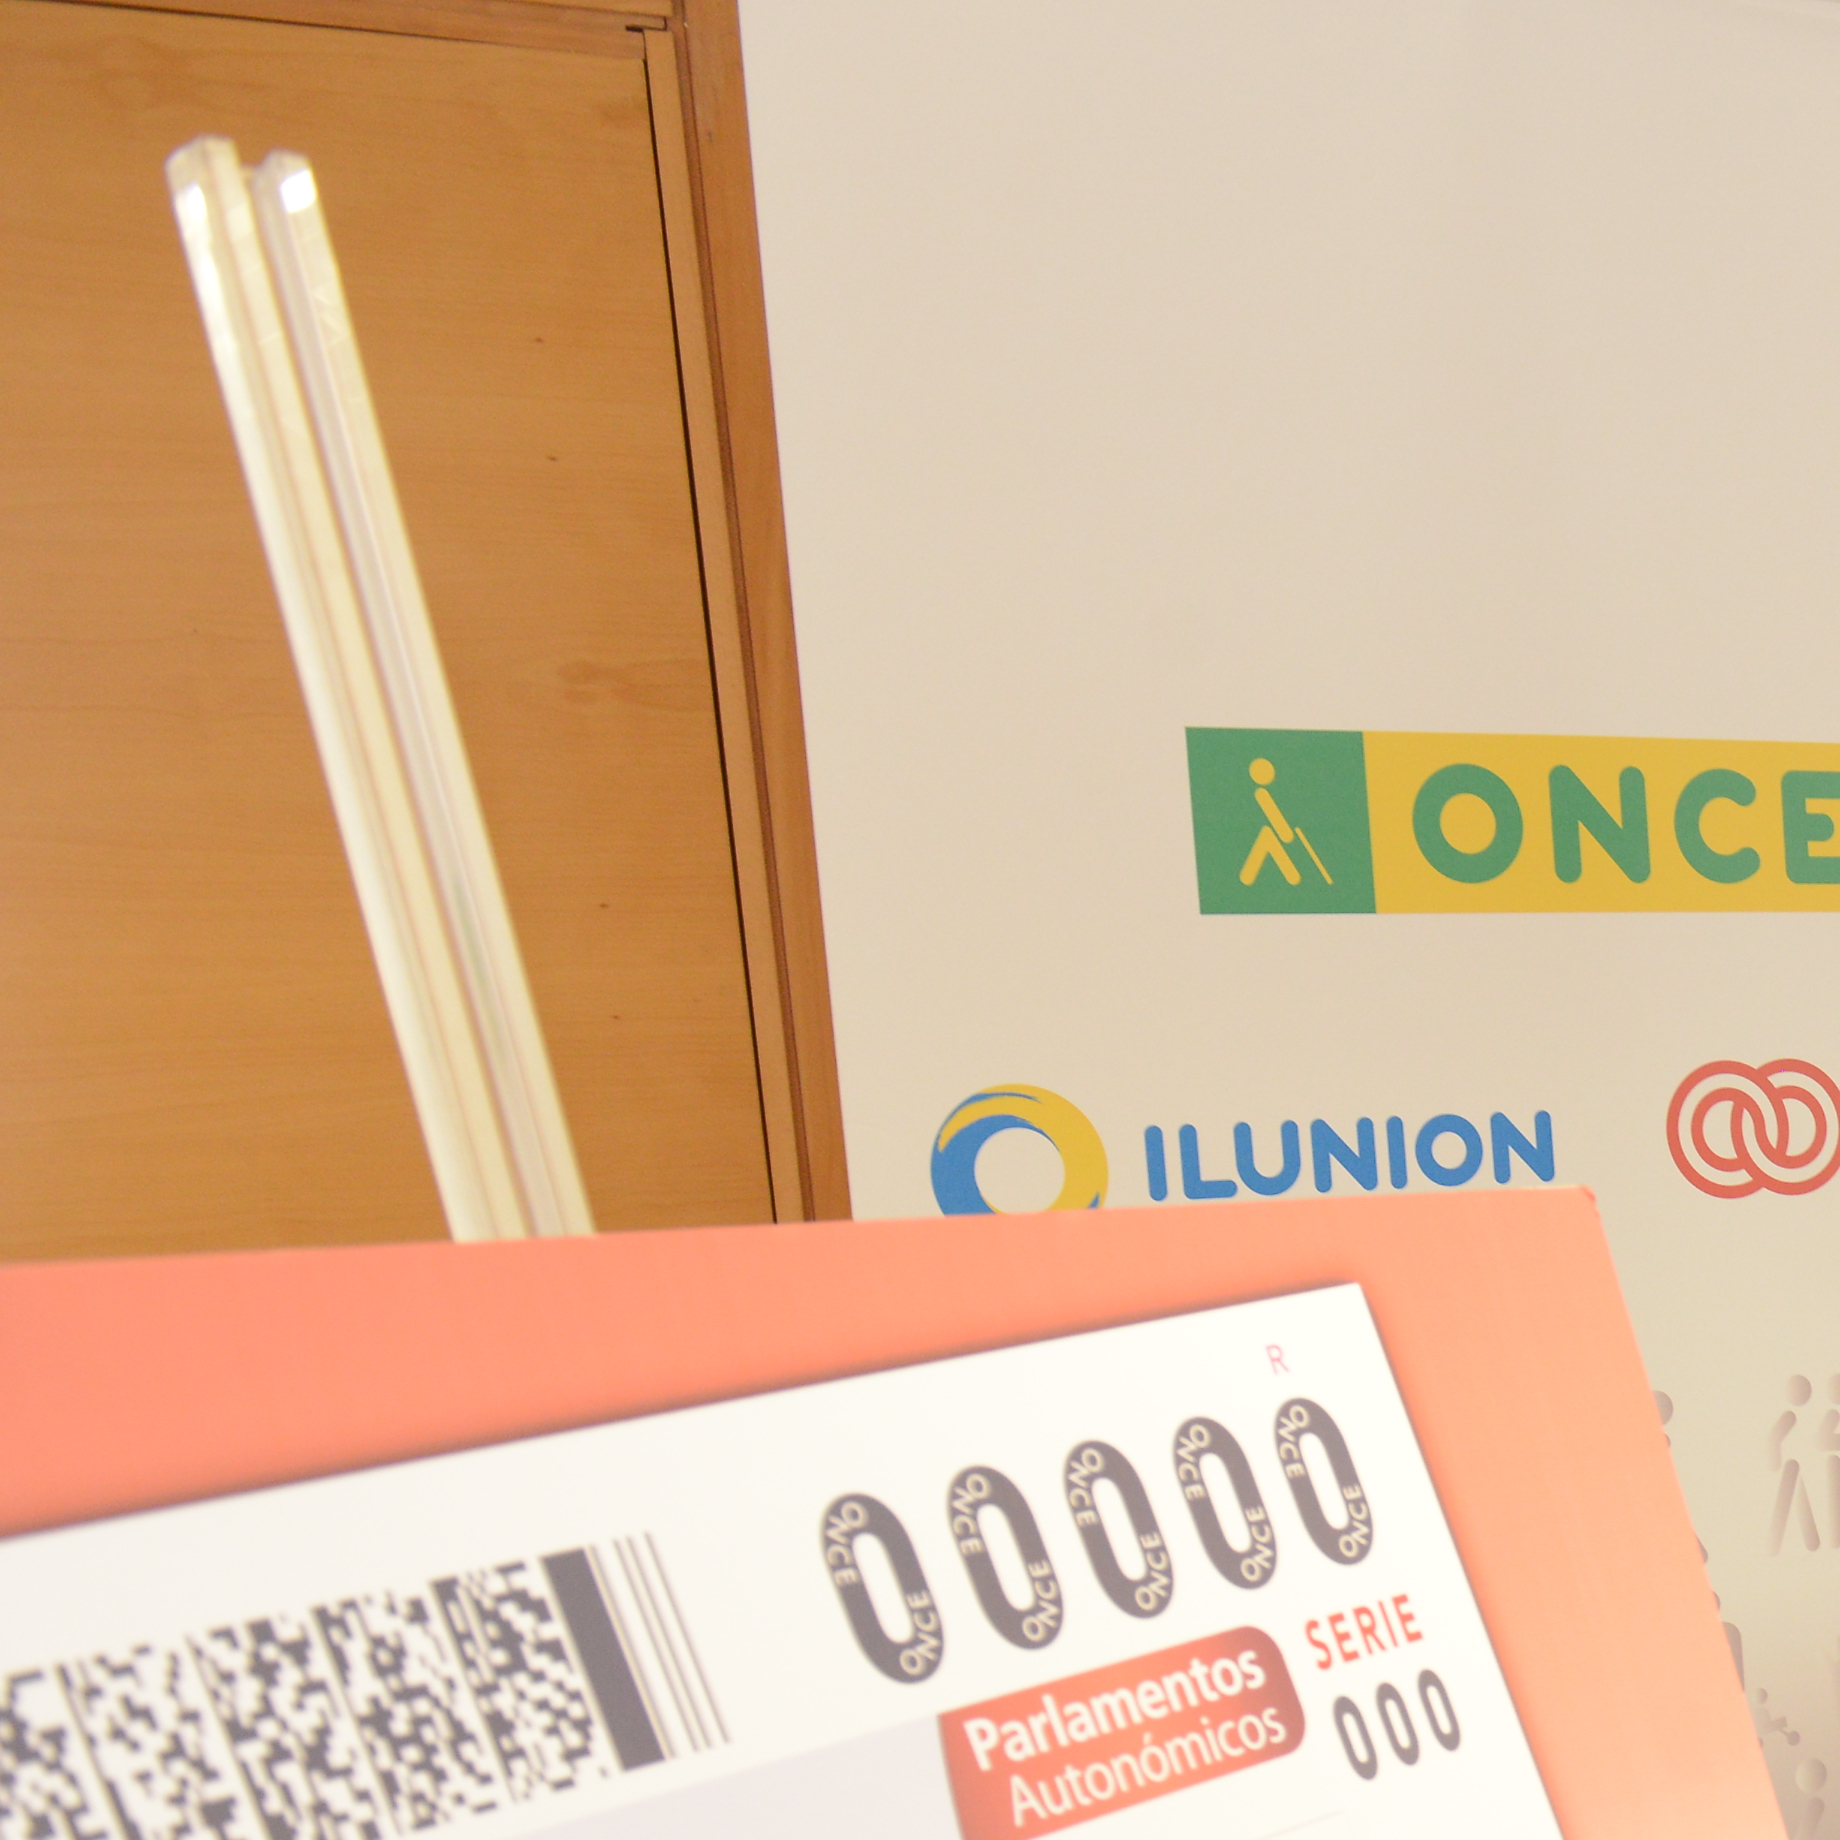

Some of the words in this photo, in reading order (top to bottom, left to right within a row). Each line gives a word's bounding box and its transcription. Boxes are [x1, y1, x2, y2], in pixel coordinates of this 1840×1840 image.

[1144, 1110, 1556, 1201] ILUNION
[1177, 1424, 1211, 1500] ONCE
[1278, 1405, 1310, 1478] ONCE
[952, 1473, 990, 1555] ONCE
[1068, 1448, 1104, 1527] ONCE
[1338, 1483, 1371, 1557] ONCE
[820, 1397, 1374, 1684] 00000
[826, 1501, 868, 1587] ONCE
[1134, 1531, 1171, 1610] ONCE
[1240, 1505, 1274, 1582] ONCE
[900, 1590, 941, 1675] ONCE
[1021, 1560, 1061, 1642] ONCE
[1304, 1594, 1424, 1671] SERIE
[962, 1647, 1267, 1772] Parlamentos
[1332, 1668, 1462, 1781] 000
[1008, 1703, 1287, 1828] Autonómicos
